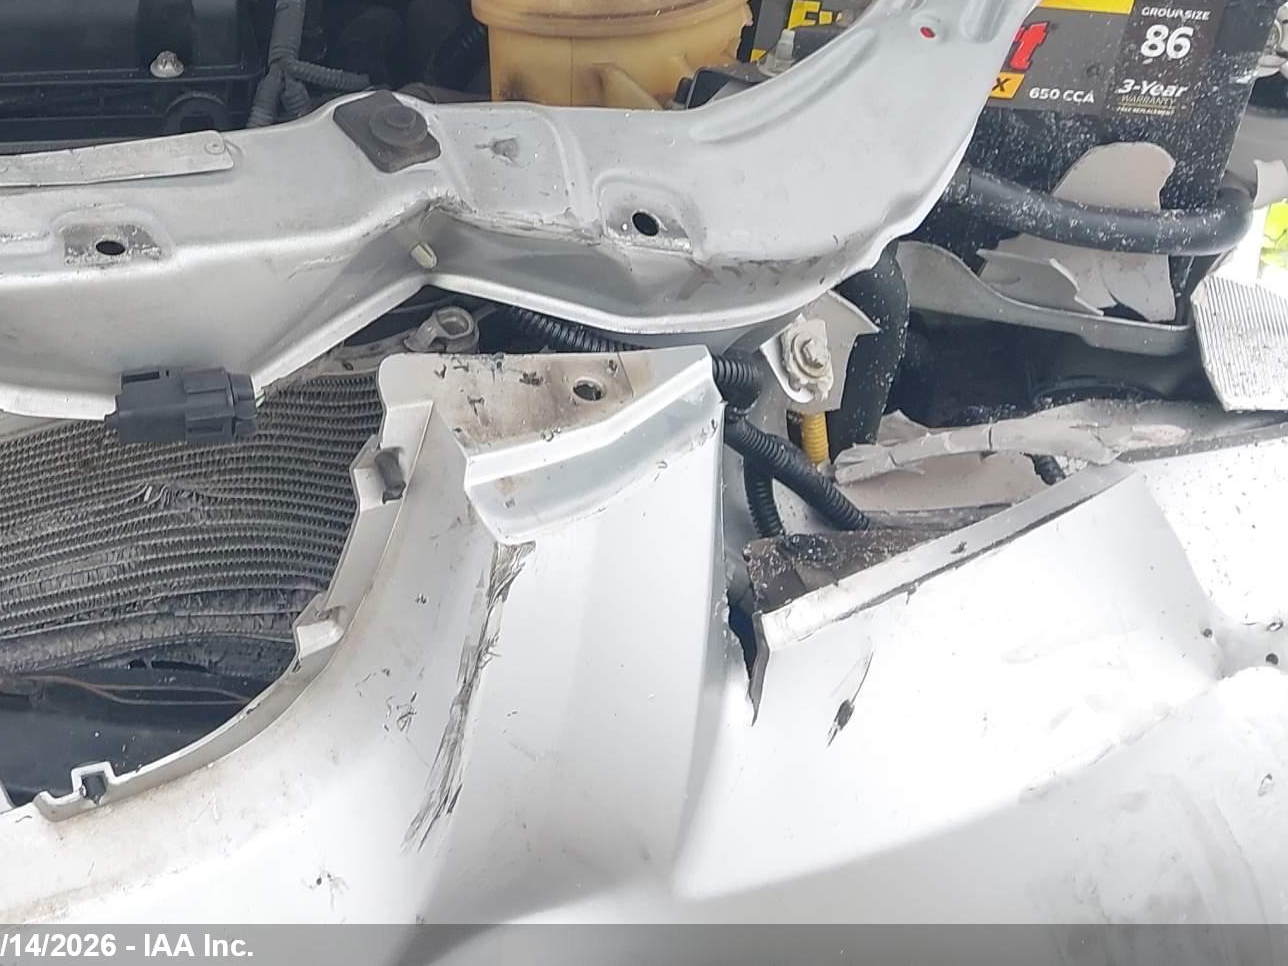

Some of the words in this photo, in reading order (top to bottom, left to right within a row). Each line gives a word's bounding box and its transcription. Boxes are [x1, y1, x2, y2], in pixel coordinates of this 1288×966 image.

[1140, 24, 1195, 60] 86
[1029, 87, 1060, 101] 650
[1062, 89, 1095, 103] CCA
[1117, 79, 1189, 98] 3-Year
[1120, 95, 1177, 107] WARRANTY
